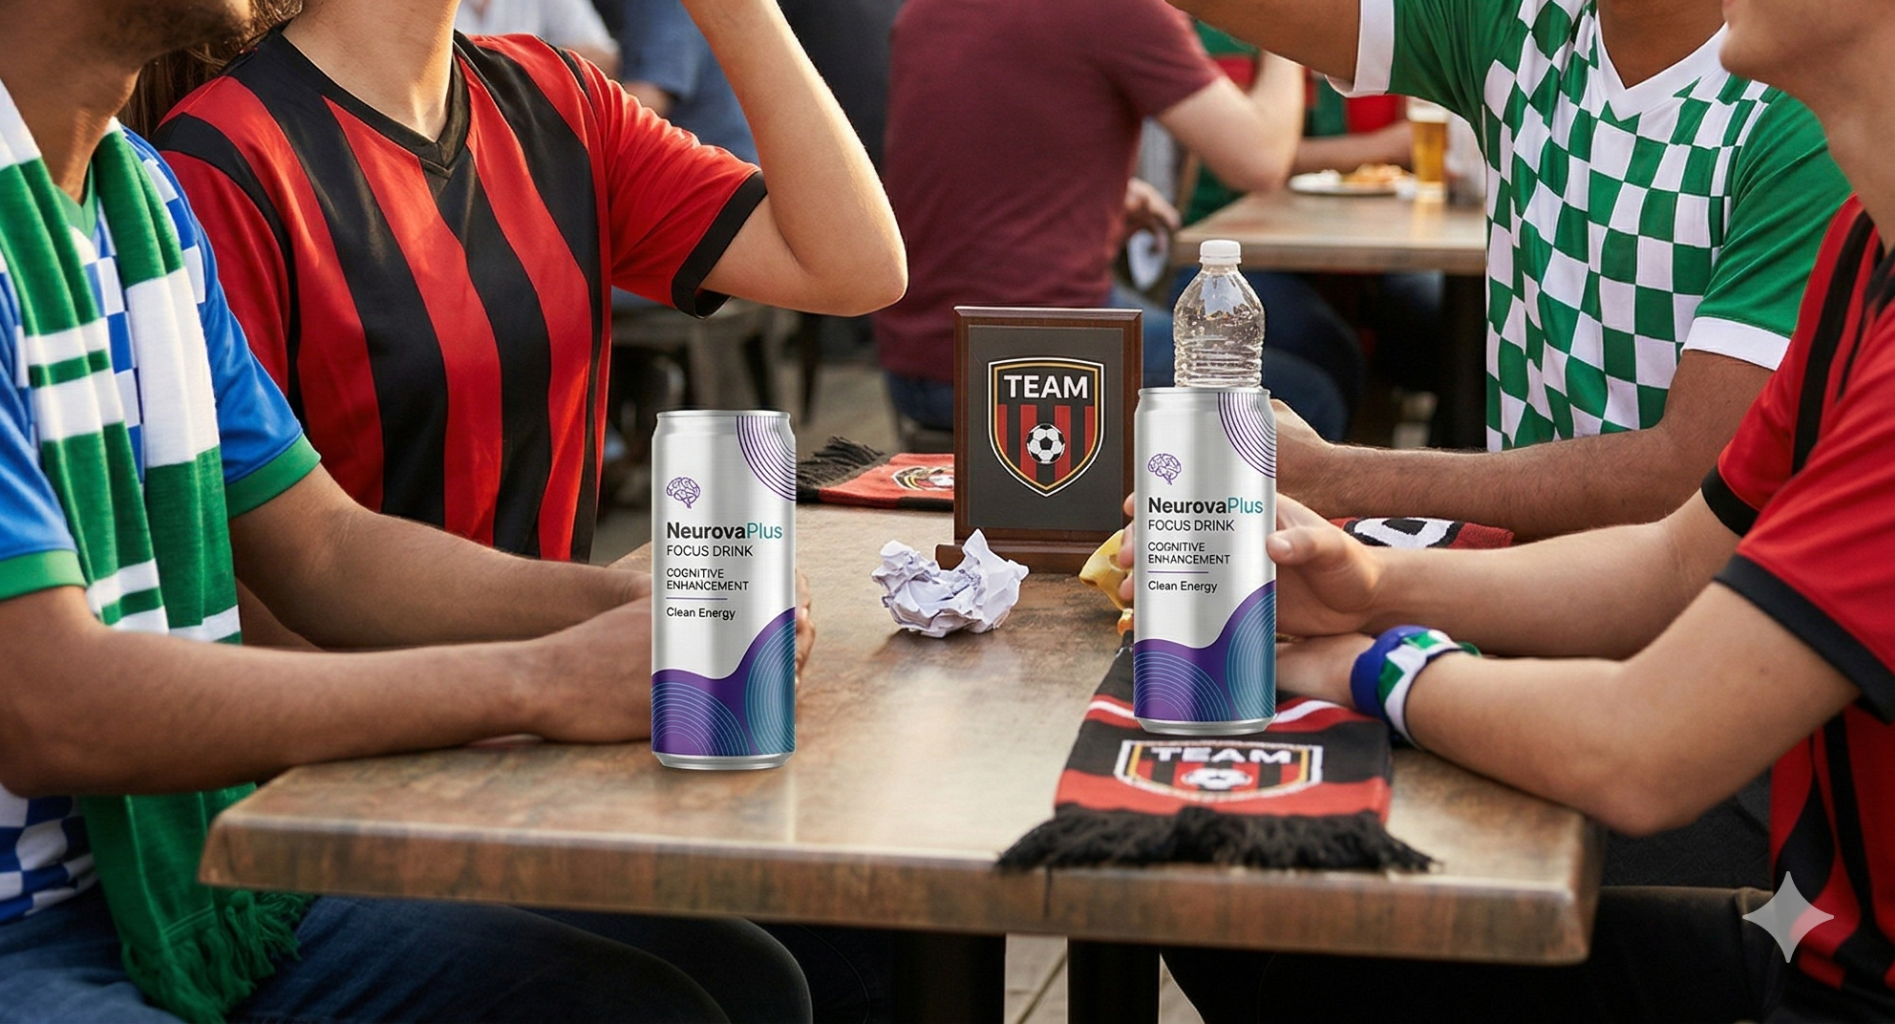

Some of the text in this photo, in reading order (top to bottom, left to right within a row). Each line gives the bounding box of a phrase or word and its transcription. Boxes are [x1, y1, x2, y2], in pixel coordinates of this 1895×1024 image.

[1003, 374, 1088, 399] TEAM
[1148, 497, 1263, 514] NeurovaPlus
[667, 522, 783, 540] NeurovaPlus
[1148, 519, 1235, 532] FOCUS DRINK
[667, 545, 753, 557] FOCUS DRINK
[1148, 542, 1205, 553] COGNITIVE
[1148, 554, 1230, 565] ENHANCEMENT
[667, 568, 724, 579] COGNITIVE
[667, 580, 749, 591] ENHANCEMENT
[1148, 580, 1217, 593] Clean Energy
[667, 607, 736, 620] Clean Energy
[1151, 746, 1292, 765] TEAM
